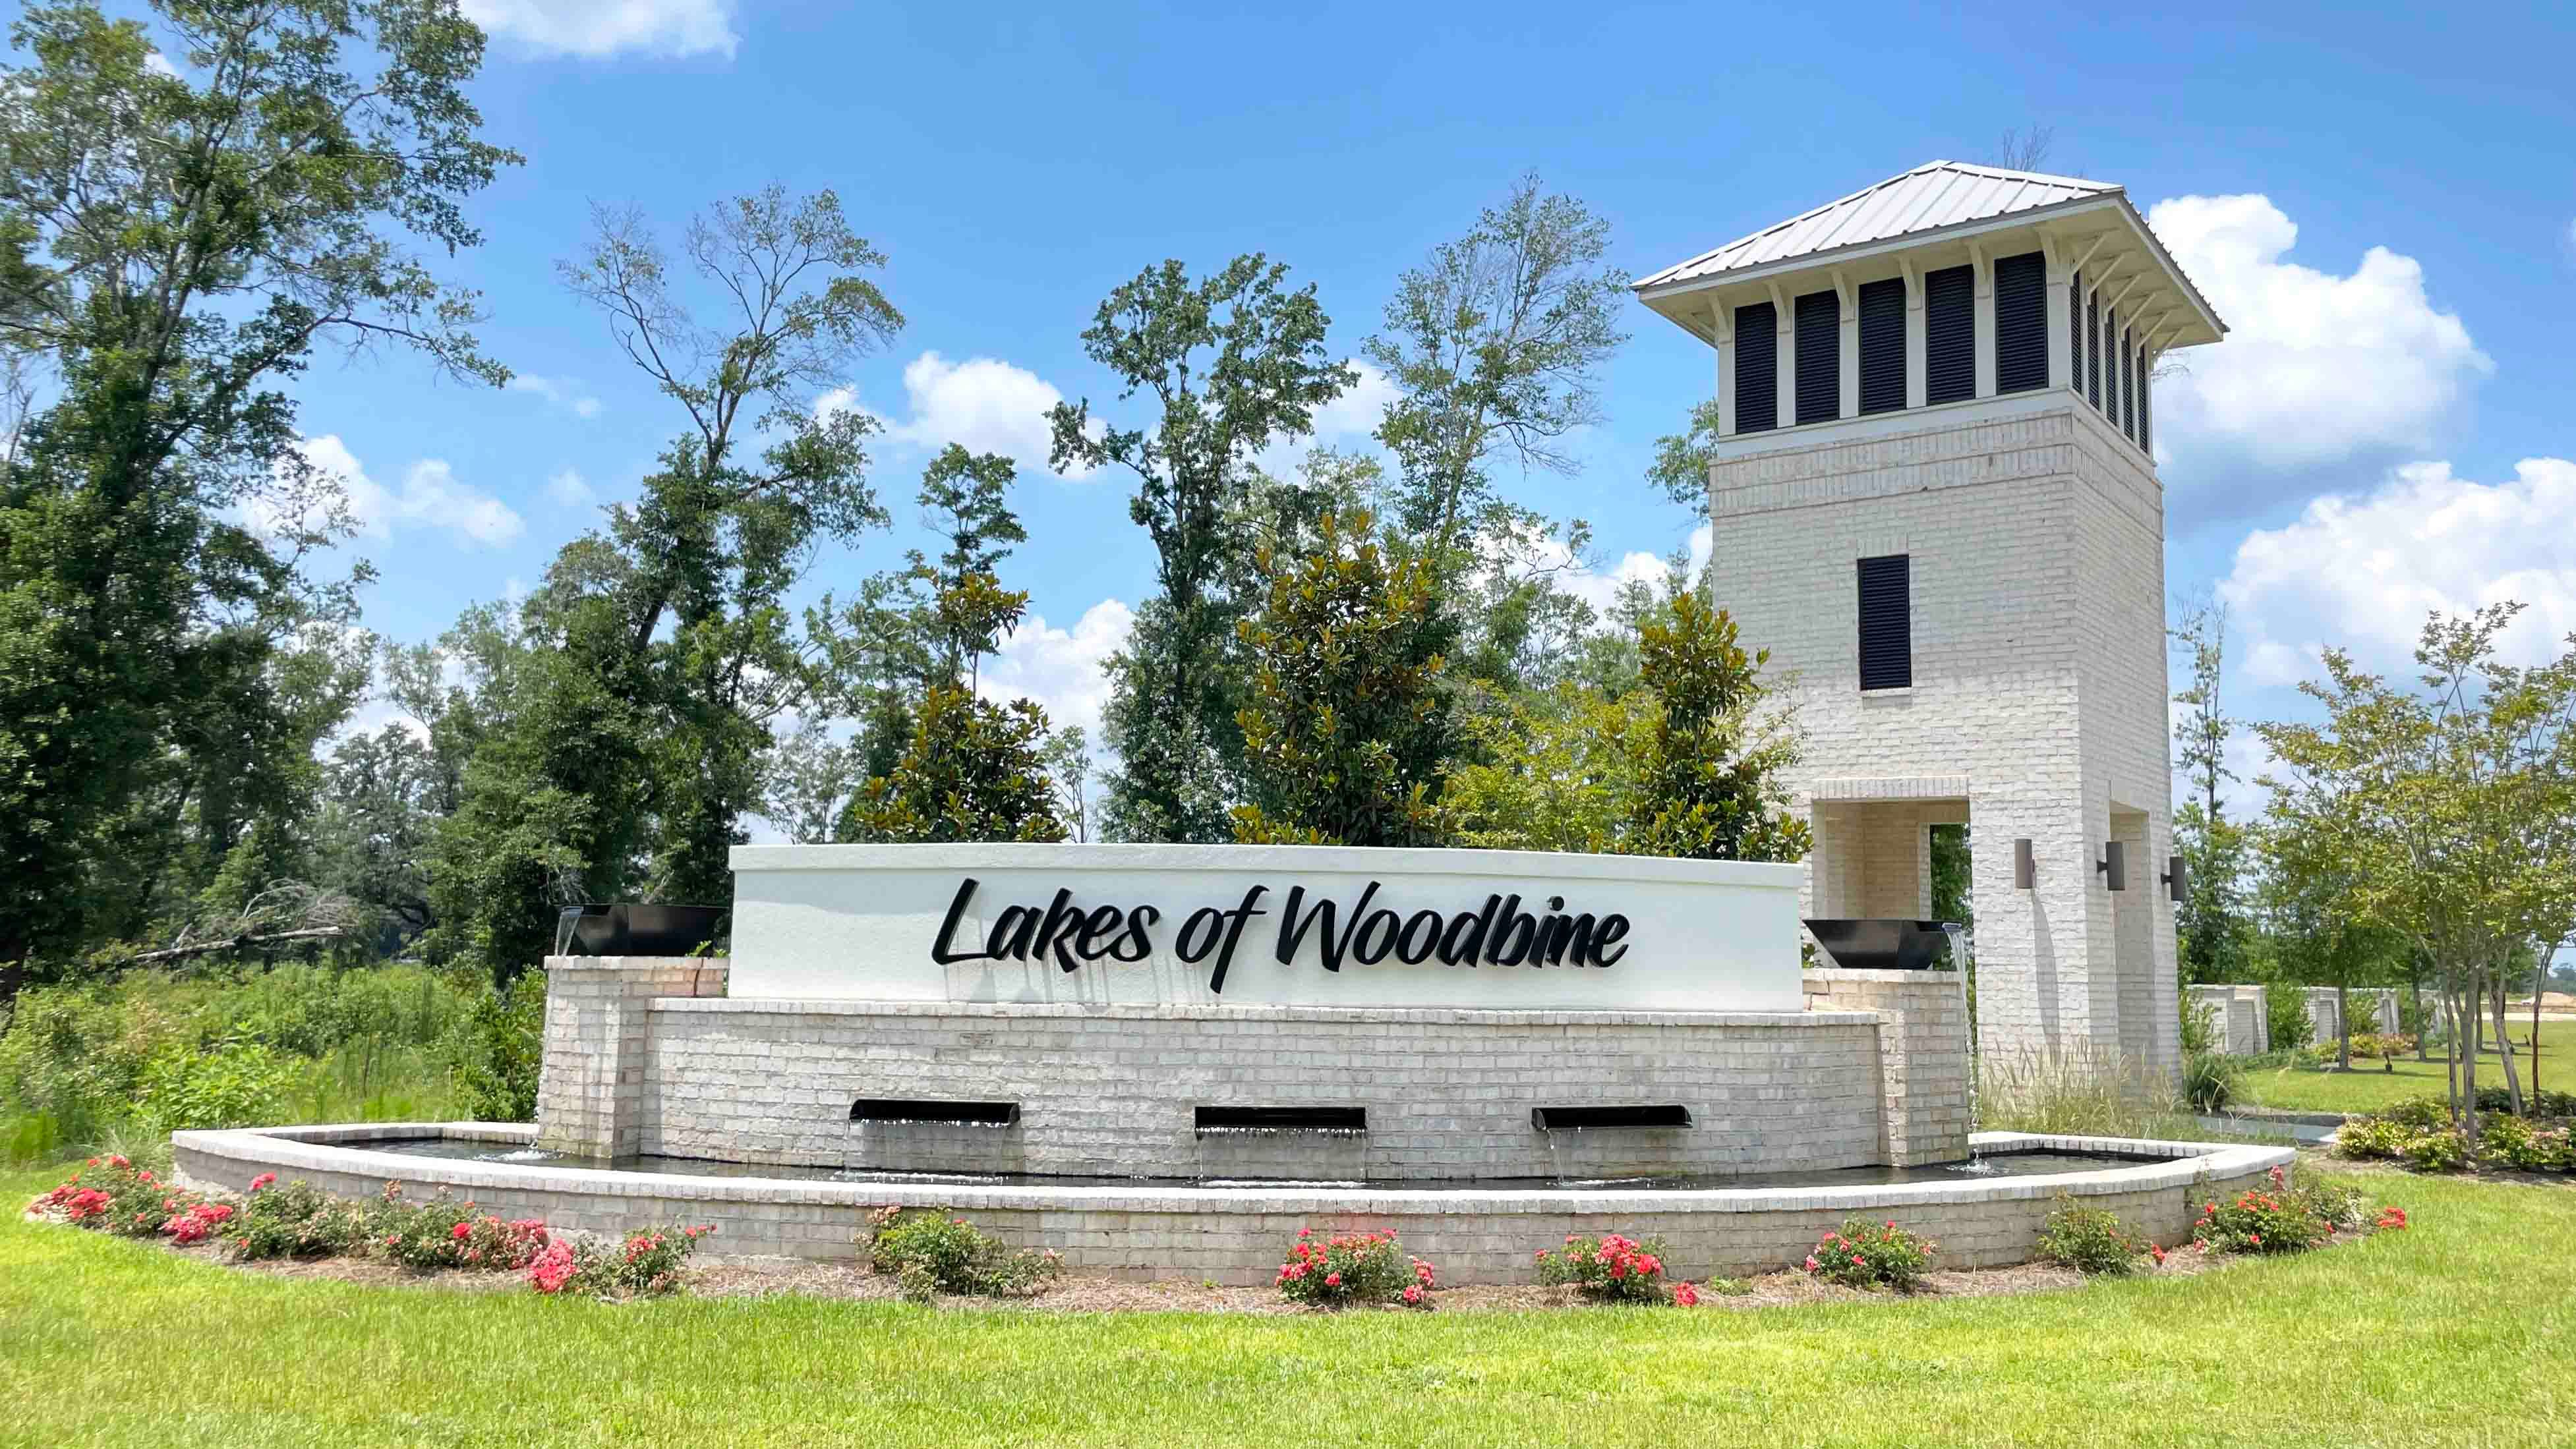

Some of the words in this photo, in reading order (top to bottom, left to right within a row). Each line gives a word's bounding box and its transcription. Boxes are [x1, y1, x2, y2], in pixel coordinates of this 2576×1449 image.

[931, 878, 1160, 973] Lakes
[1175, 885, 1270, 994] of
[1275, 881, 1630, 973] Woodbine
